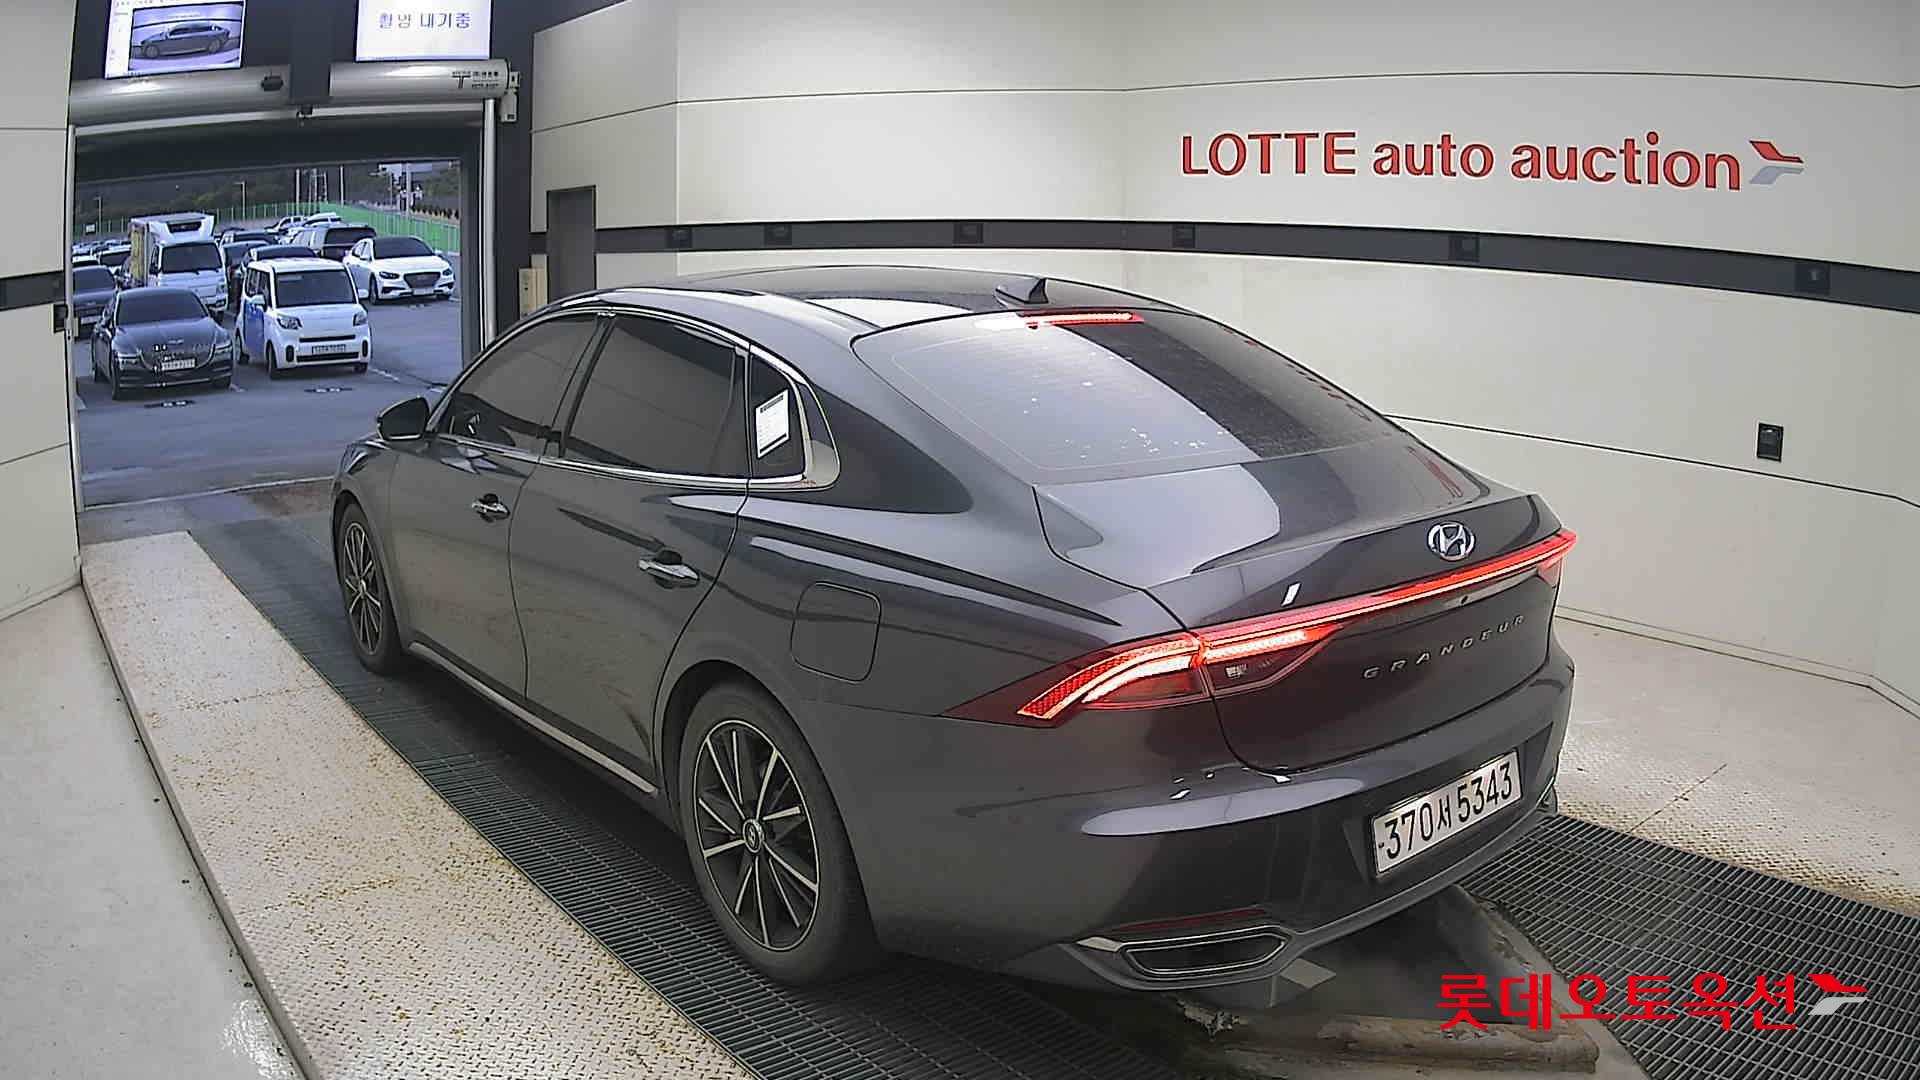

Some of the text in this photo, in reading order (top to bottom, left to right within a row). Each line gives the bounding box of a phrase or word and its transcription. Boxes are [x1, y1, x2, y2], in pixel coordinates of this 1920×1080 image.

[1181, 131, 1741, 191] LOTTE auto auction
[1363, 615, 1525, 680] GRANDEUR
